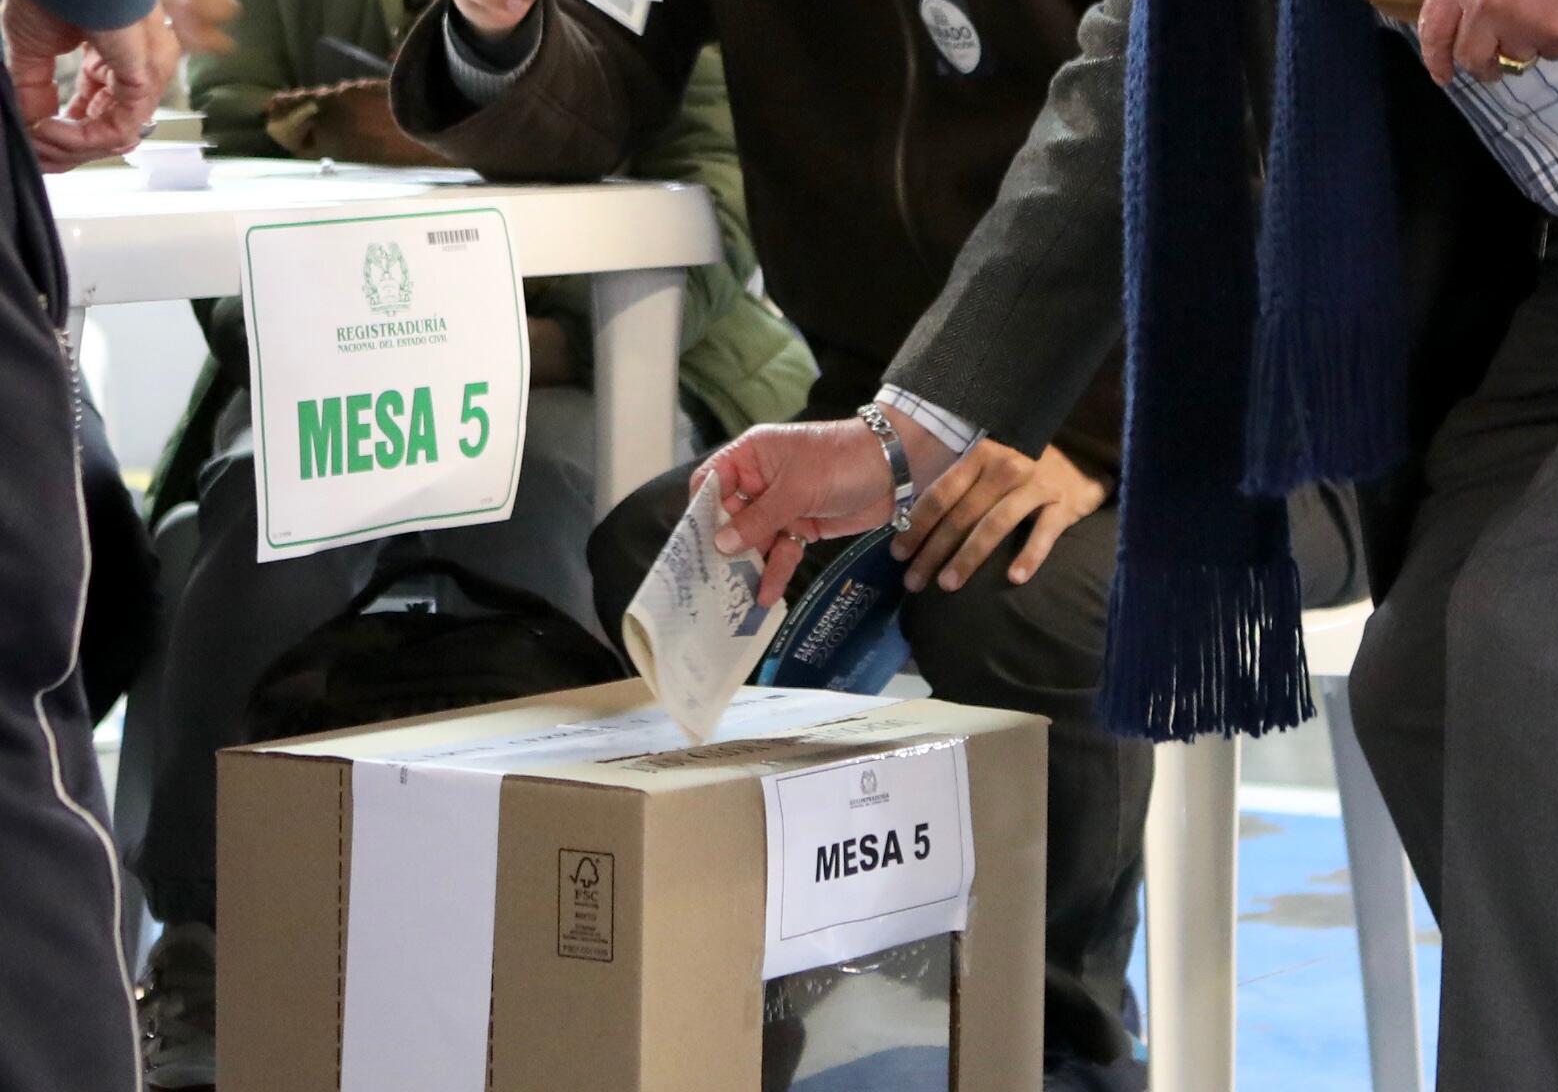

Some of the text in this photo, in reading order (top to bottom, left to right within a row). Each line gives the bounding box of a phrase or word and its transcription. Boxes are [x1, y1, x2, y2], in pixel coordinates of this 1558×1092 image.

[337, 314, 447, 341] REGISTRADURÍA
[338, 334, 447, 354] NACIONAL DEL ESTADO CIVIL
[297, 381, 490, 480] MESA 5
[815, 822, 931, 884] MESA 5
